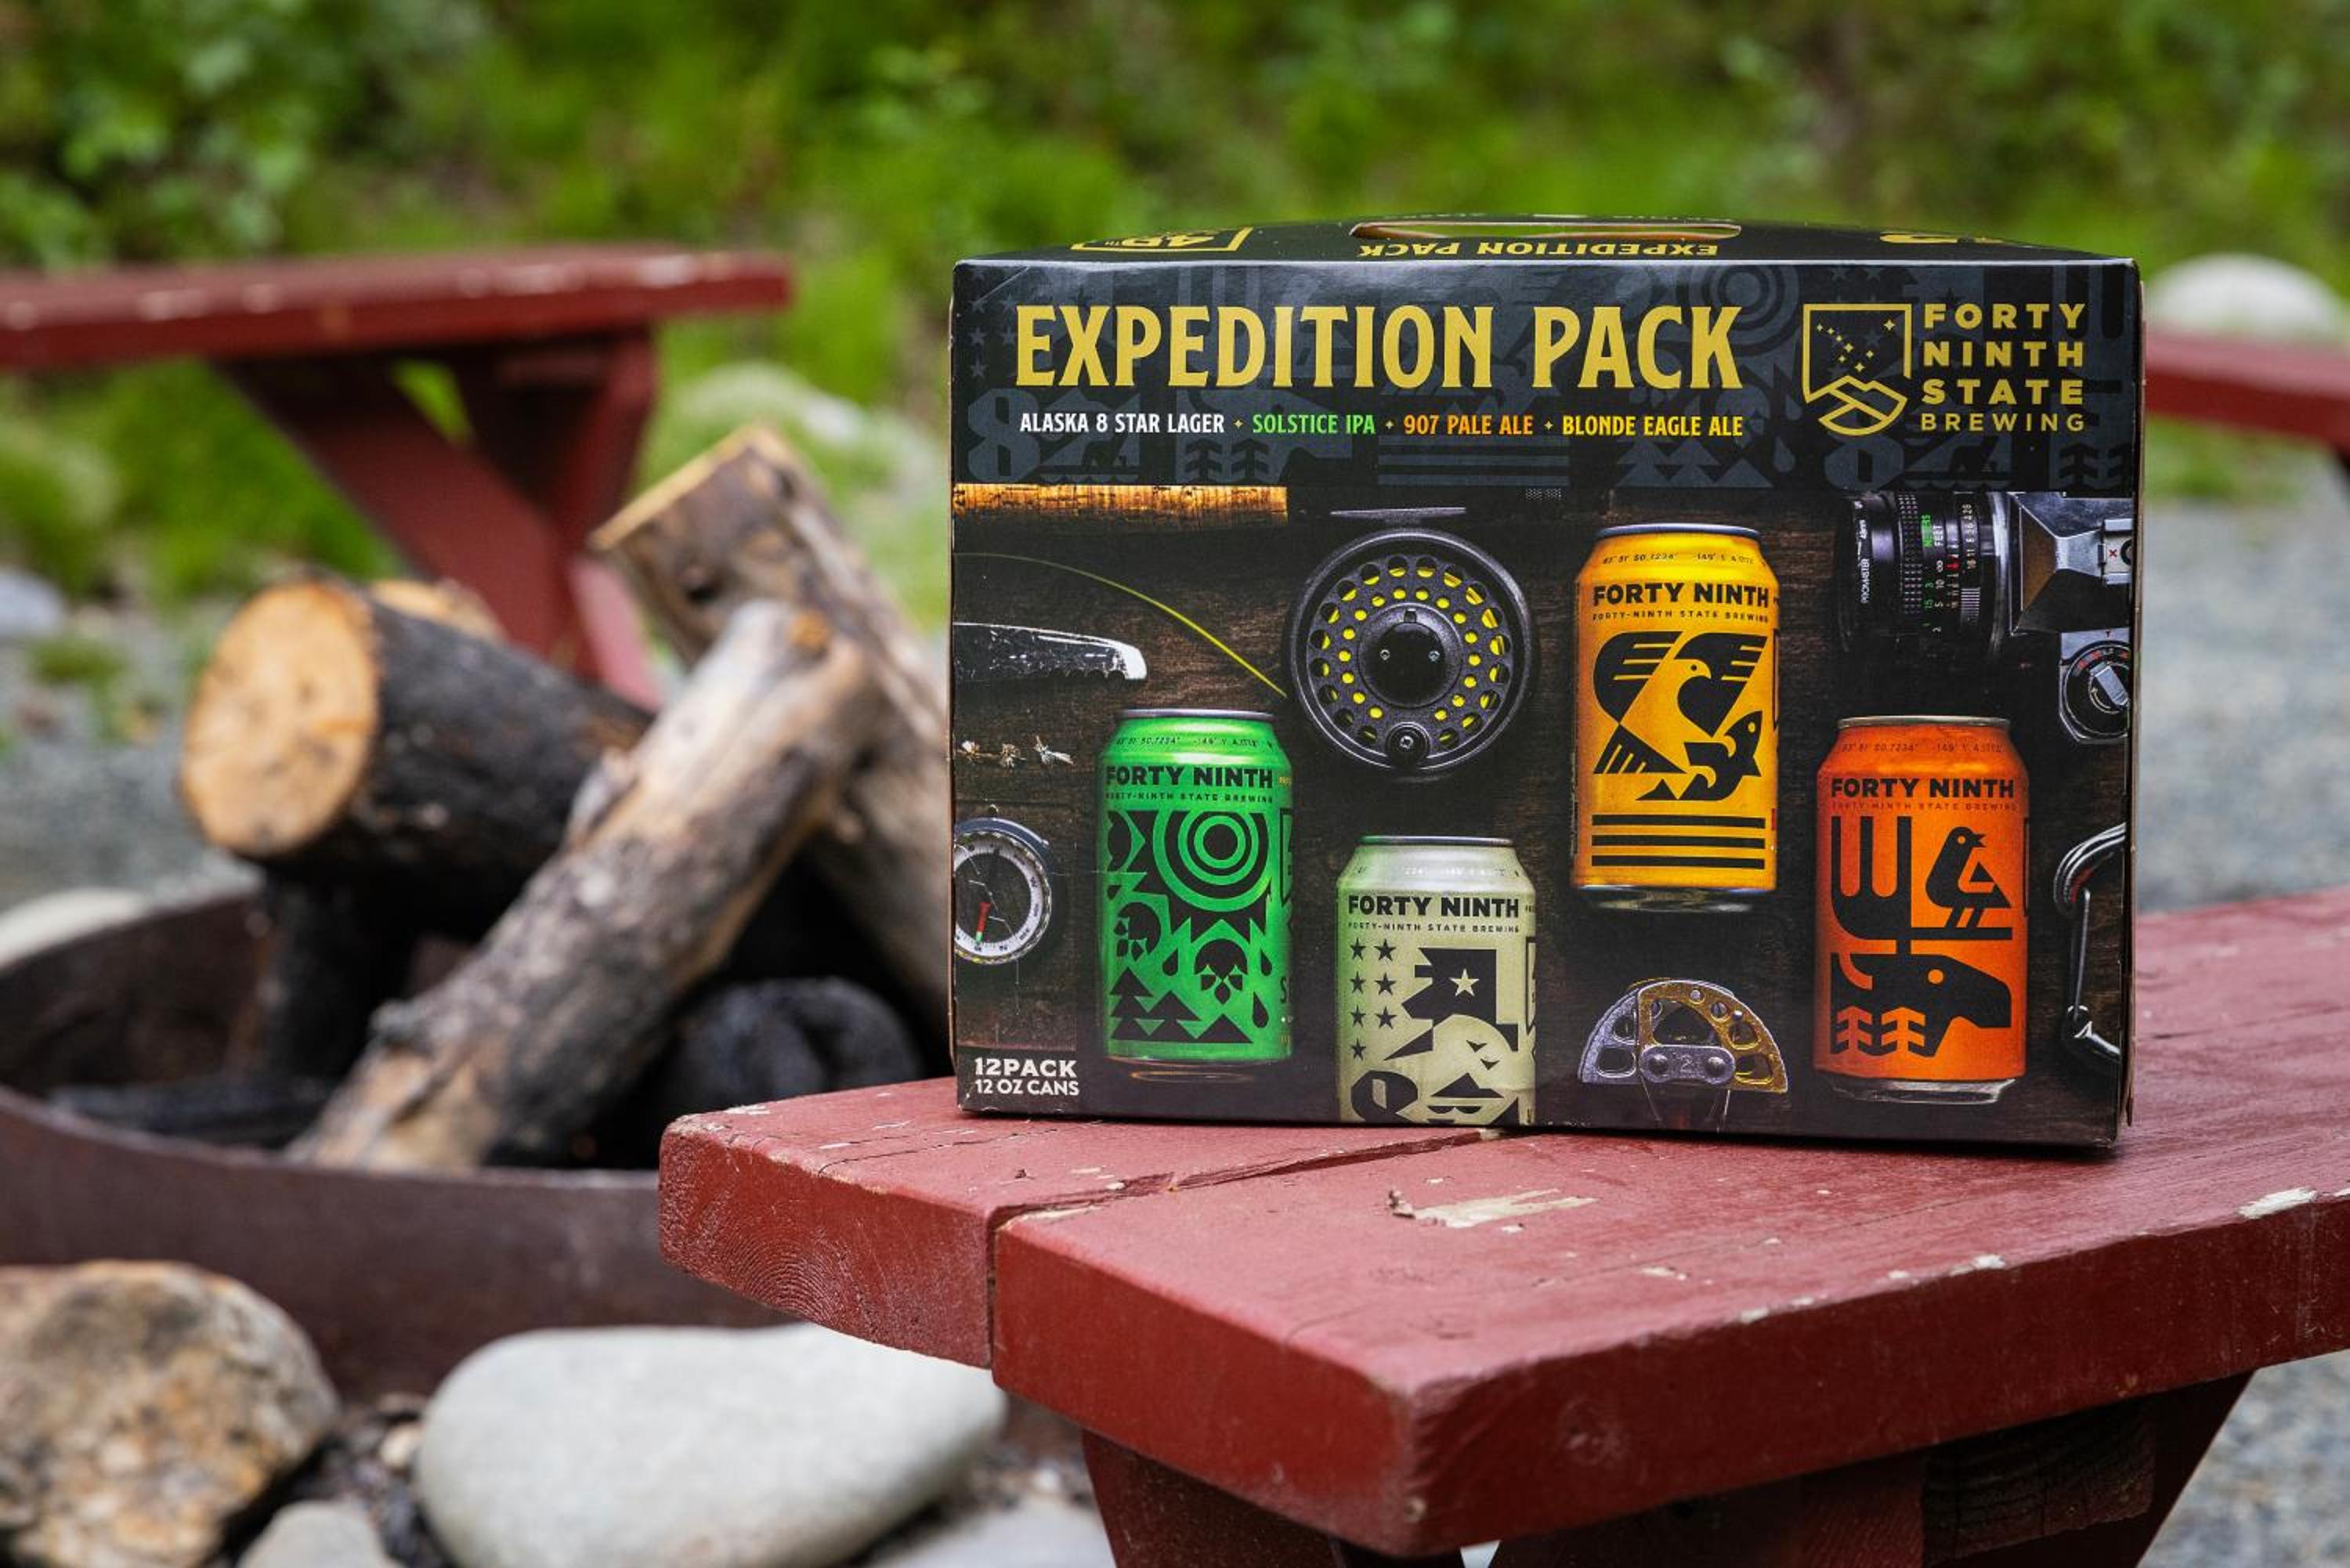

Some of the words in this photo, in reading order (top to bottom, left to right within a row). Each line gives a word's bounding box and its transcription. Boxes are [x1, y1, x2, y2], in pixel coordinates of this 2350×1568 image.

[1361, 242, 1461, 256] PACK
[1477, 242, 1719, 255] EXPEDITION
[1925, 303, 2085, 329] FORTY
[1016, 305, 1494, 388] EXPEDITION
[1531, 305, 1743, 389] PACK
[1924, 341, 2083, 367] NINTH
[1922, 379, 2083, 405] STATE
[1020, 414, 1089, 432] ALASKA
[1096, 414, 1108, 432] 8
[1115, 414, 1160, 433] STAR
[1167, 414, 1224, 434] LAGER
[1253, 414, 1338, 433] SOLSTICE
[1347, 414, 1376, 434] IPA
[1404, 414, 1440, 435] 907
[1448, 415, 1492, 435] PALE
[1499, 415, 1534, 435] ALE
[1563, 416, 1636, 435] BLONDE
[1643, 416, 1701, 436] EAGLE
[1708, 416, 1743, 436] ALE
[1922, 414, 2084, 432] BREWING
[1933, 526, 1943, 547] FEET
[1593, 583, 1684, 606] FORTY
[1694, 583, 1769, 608] NINTH
[1106, 765, 1185, 786] FORTY
[1194, 767, 1273, 788] NINTH
[1831, 778, 1919, 797] FORTY
[1930, 778, 2015, 797] NINTH
[1348, 895, 1432, 916] FORTY
[1441, 897, 1519, 918] NINTH
[1428, 923, 1466, 932] STATE
[974, 1078, 992, 1093] 12
[996, 1078, 1023, 1094] OZ
[1027, 1079, 1079, 1096] CANS
